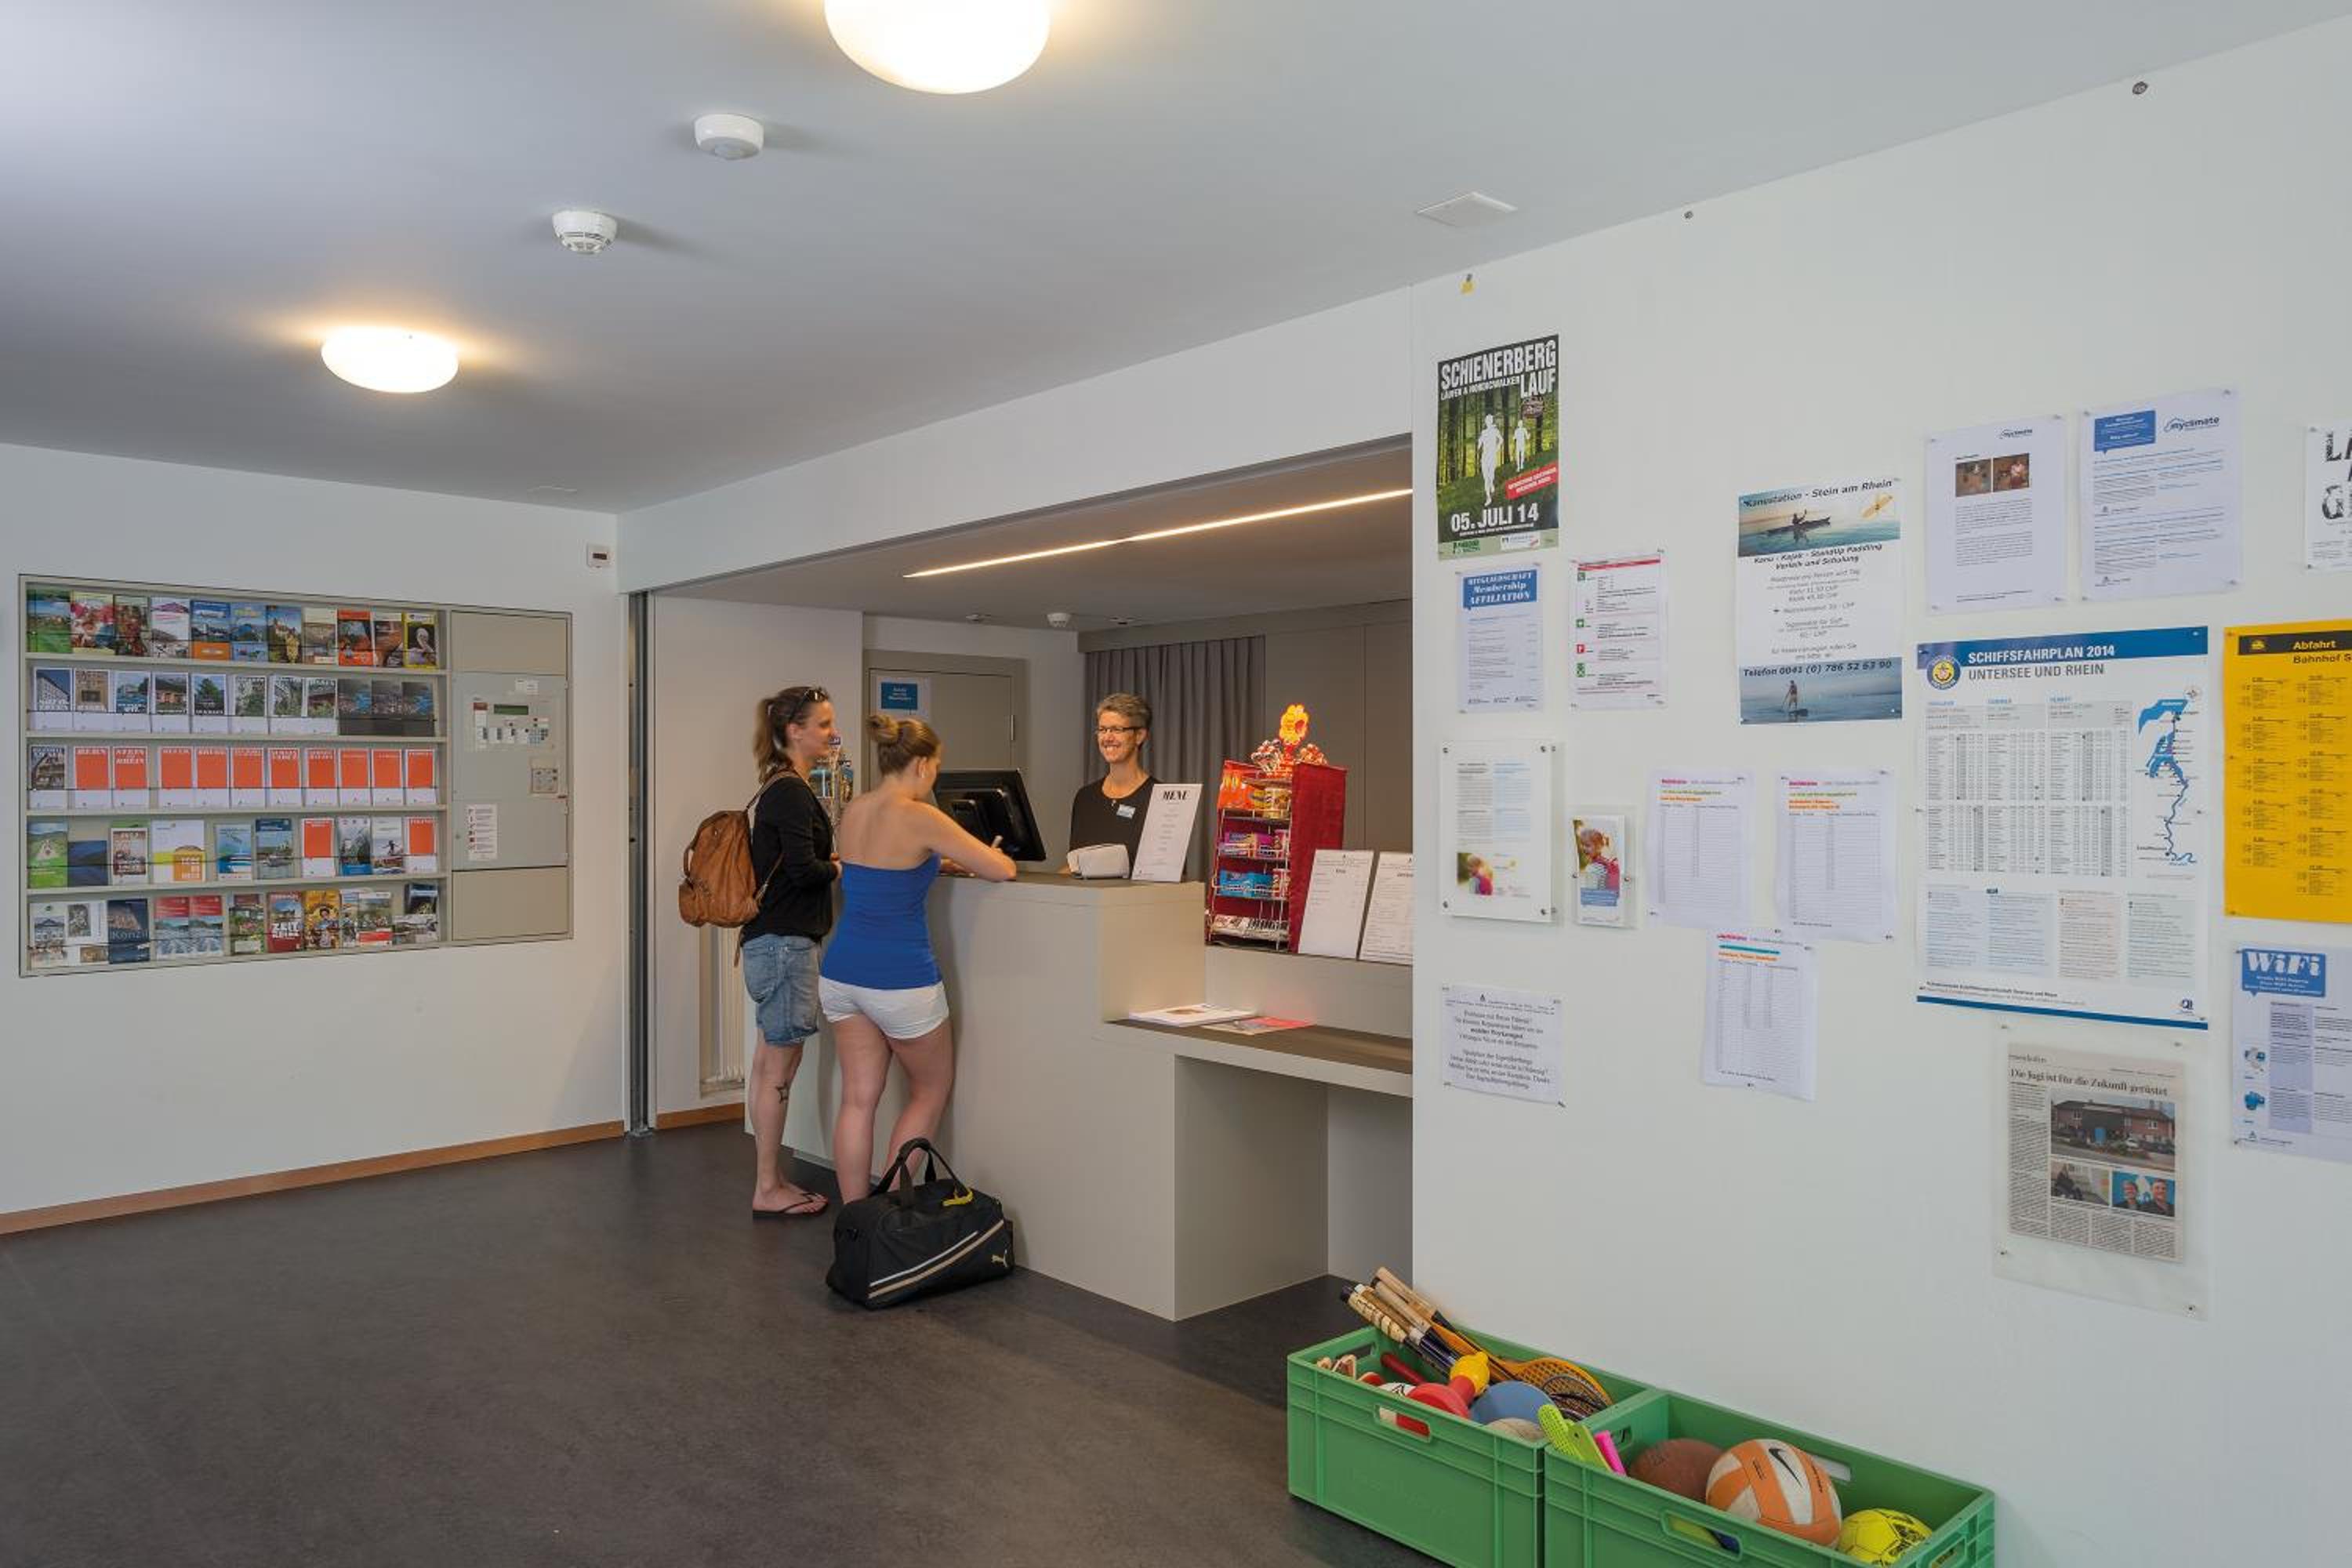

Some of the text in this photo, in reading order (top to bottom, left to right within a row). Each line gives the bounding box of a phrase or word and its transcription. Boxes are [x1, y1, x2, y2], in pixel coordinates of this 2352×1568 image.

[1441, 340, 1556, 390] SCHIENERBERG
[1520, 369, 1556, 398] LAUF
[1812, 486, 1838, 498] Stein
[1842, 485, 1858, 494] am
[1861, 479, 1893, 492] Rhein
[1450, 513, 1475, 532] 05.
[1479, 506, 1512, 528] JULI
[1518, 503, 1539, 523] 14
[1472, 583, 1527, 593] Membership
[1469, 592, 1530, 604] AFFILIATION
[1969, 644, 2115, 664] SCHIFFSFAHRPLAN 2014
[2293, 641, 2336, 650] Abfahrt
[2293, 653, 2340, 664] Bahnhof
[1744, 668, 1777, 677] Telefon
[1779, 666, 1802, 675] 0041
[1806, 665, 1822, 674] (0)
[1826, 663, 1843, 672] 786
[1969, 663, 2104, 681] UNTERSEE UND RHEIN
[2247, 951, 2321, 977] WiFi
[2010, 1068, 2027, 1078] Die
[2047, 1073, 2057, 1083] ist
[2058, 1073, 2073, 1084] für
[2074, 1076, 2089, 1086] die
[2090, 1079, 2127, 1091] Zukunft
[2130, 1084, 2169, 1097] gerüstet
